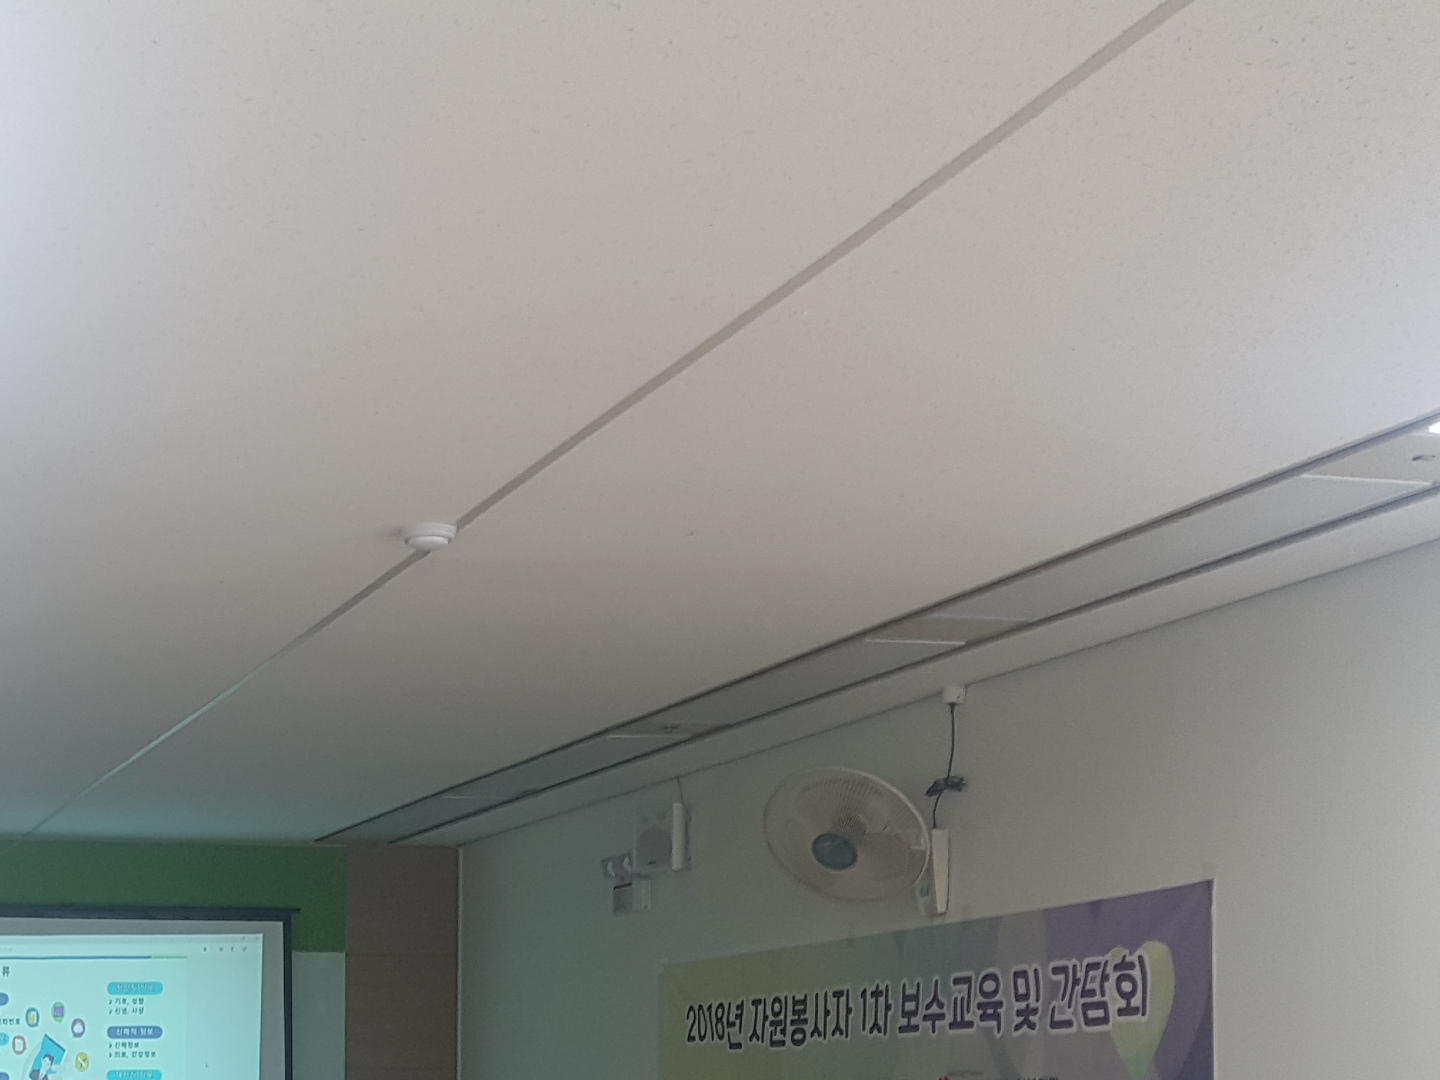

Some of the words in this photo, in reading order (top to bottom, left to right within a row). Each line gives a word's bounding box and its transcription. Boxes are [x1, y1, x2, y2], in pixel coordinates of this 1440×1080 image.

[686, 999, 745, 1050] 2018년
[749, 988, 853, 1048] 자원봉사자
[860, 983, 893, 1036] 1차
[898, 972, 1004, 1035] 보수교육
[1013, 967, 1042, 1033] 및
[1049, 954, 1148, 1030] 간담회
